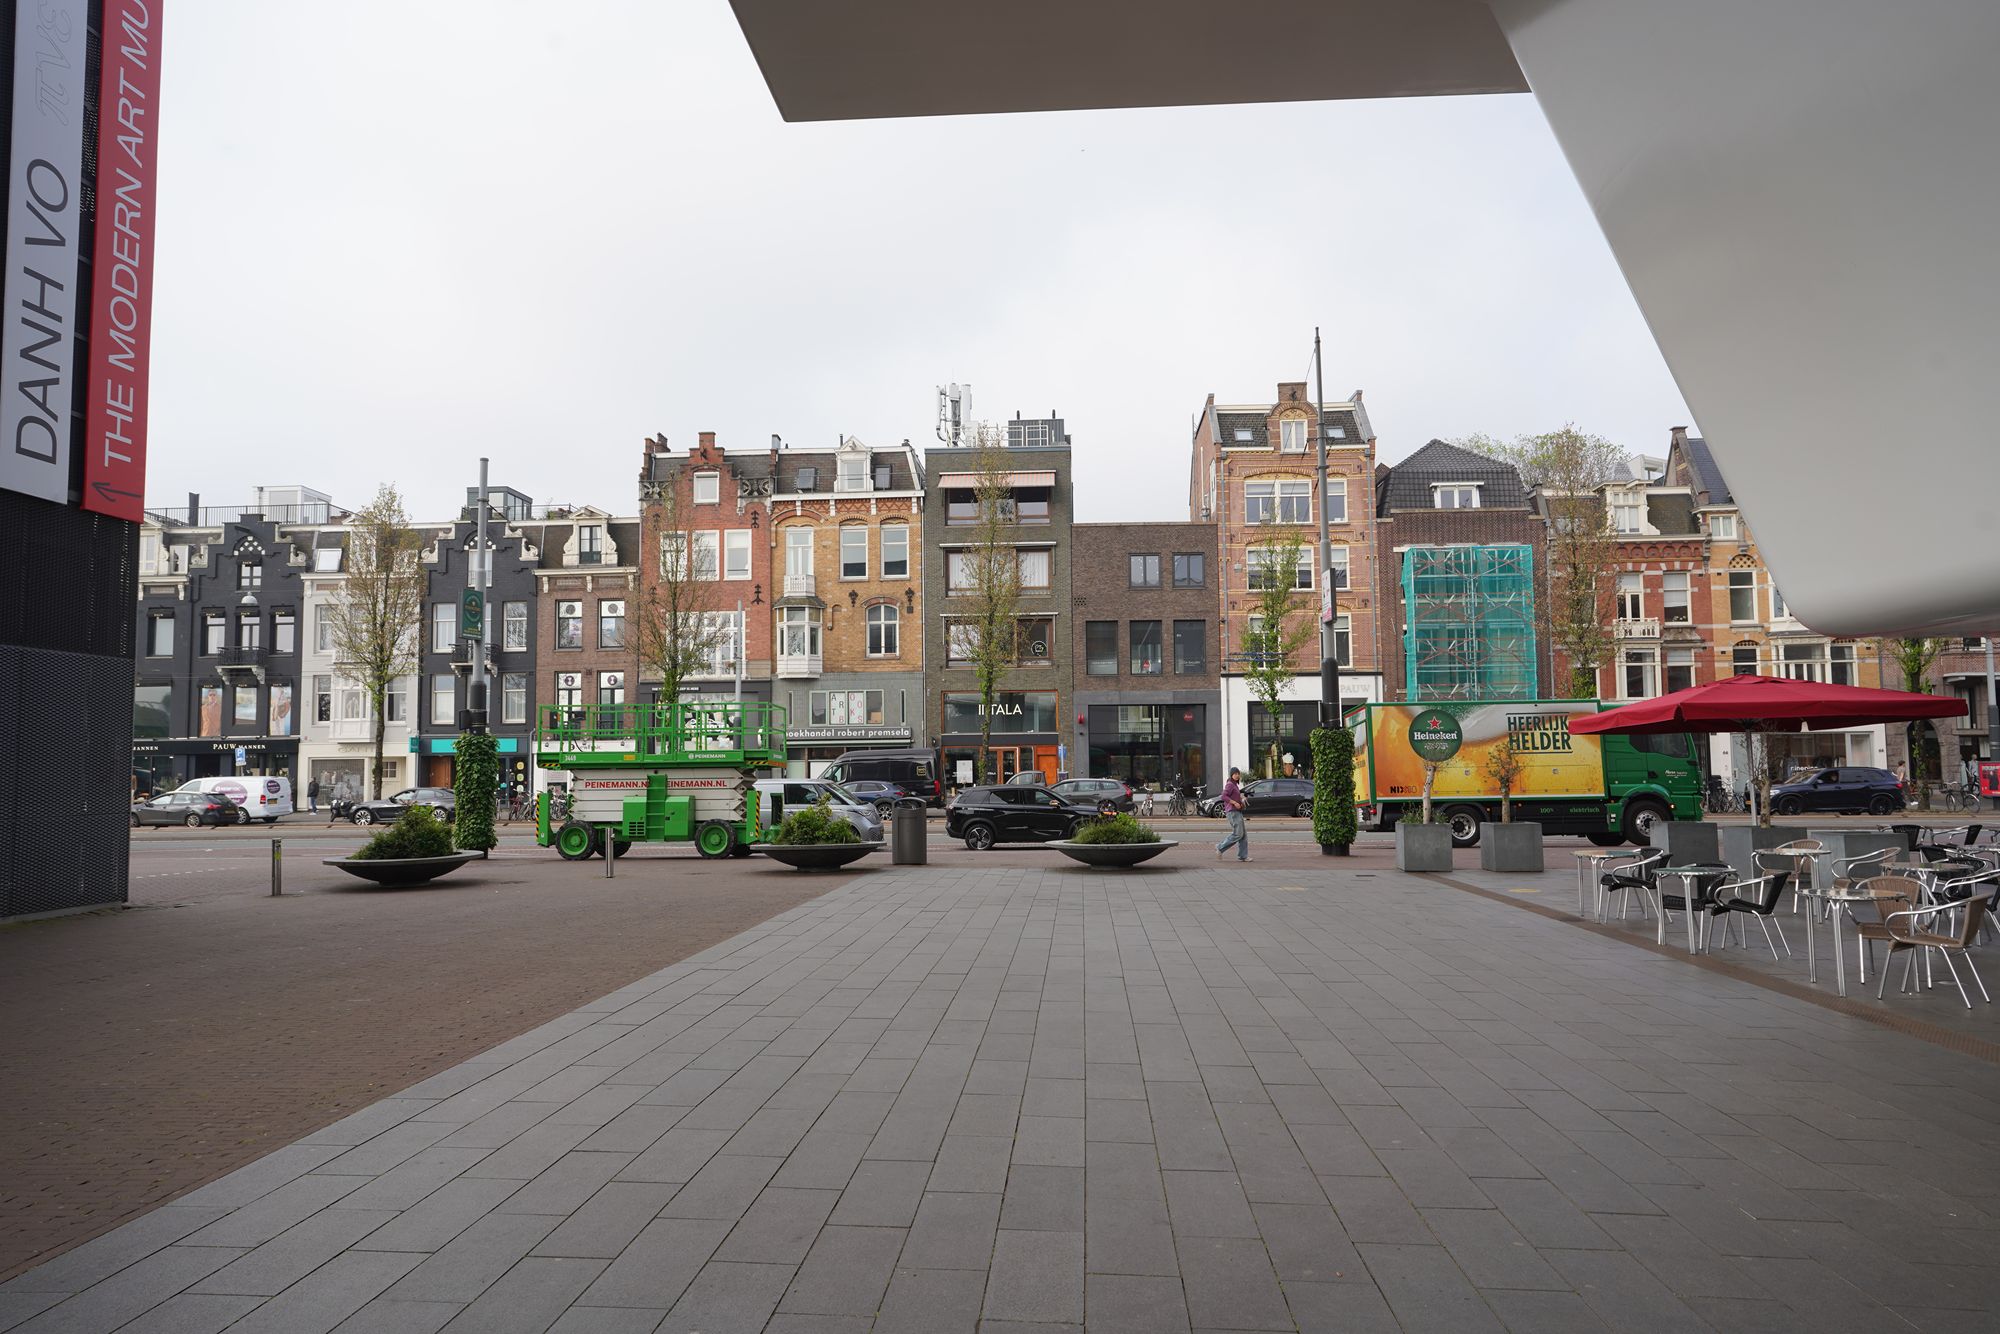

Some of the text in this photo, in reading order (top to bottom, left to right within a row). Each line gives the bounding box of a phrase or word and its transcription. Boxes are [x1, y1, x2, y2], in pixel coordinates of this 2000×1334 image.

[117, 66, 147, 168] ART
[24, 158, 69, 247] VO
[108, 168, 143, 373] MODERN
[15, 266, 65, 465] DANH
[105, 380, 135, 467] THE
[978, 704, 1022, 715] IITALA
[1340, 684, 1370, 693] PAUW
[838, 728, 865, 737] robert
[868, 728, 910, 738] premsela
[1414, 731, 1457, 740] Heineken
[1507, 715, 1572, 750] HEERLIJK HELDER
